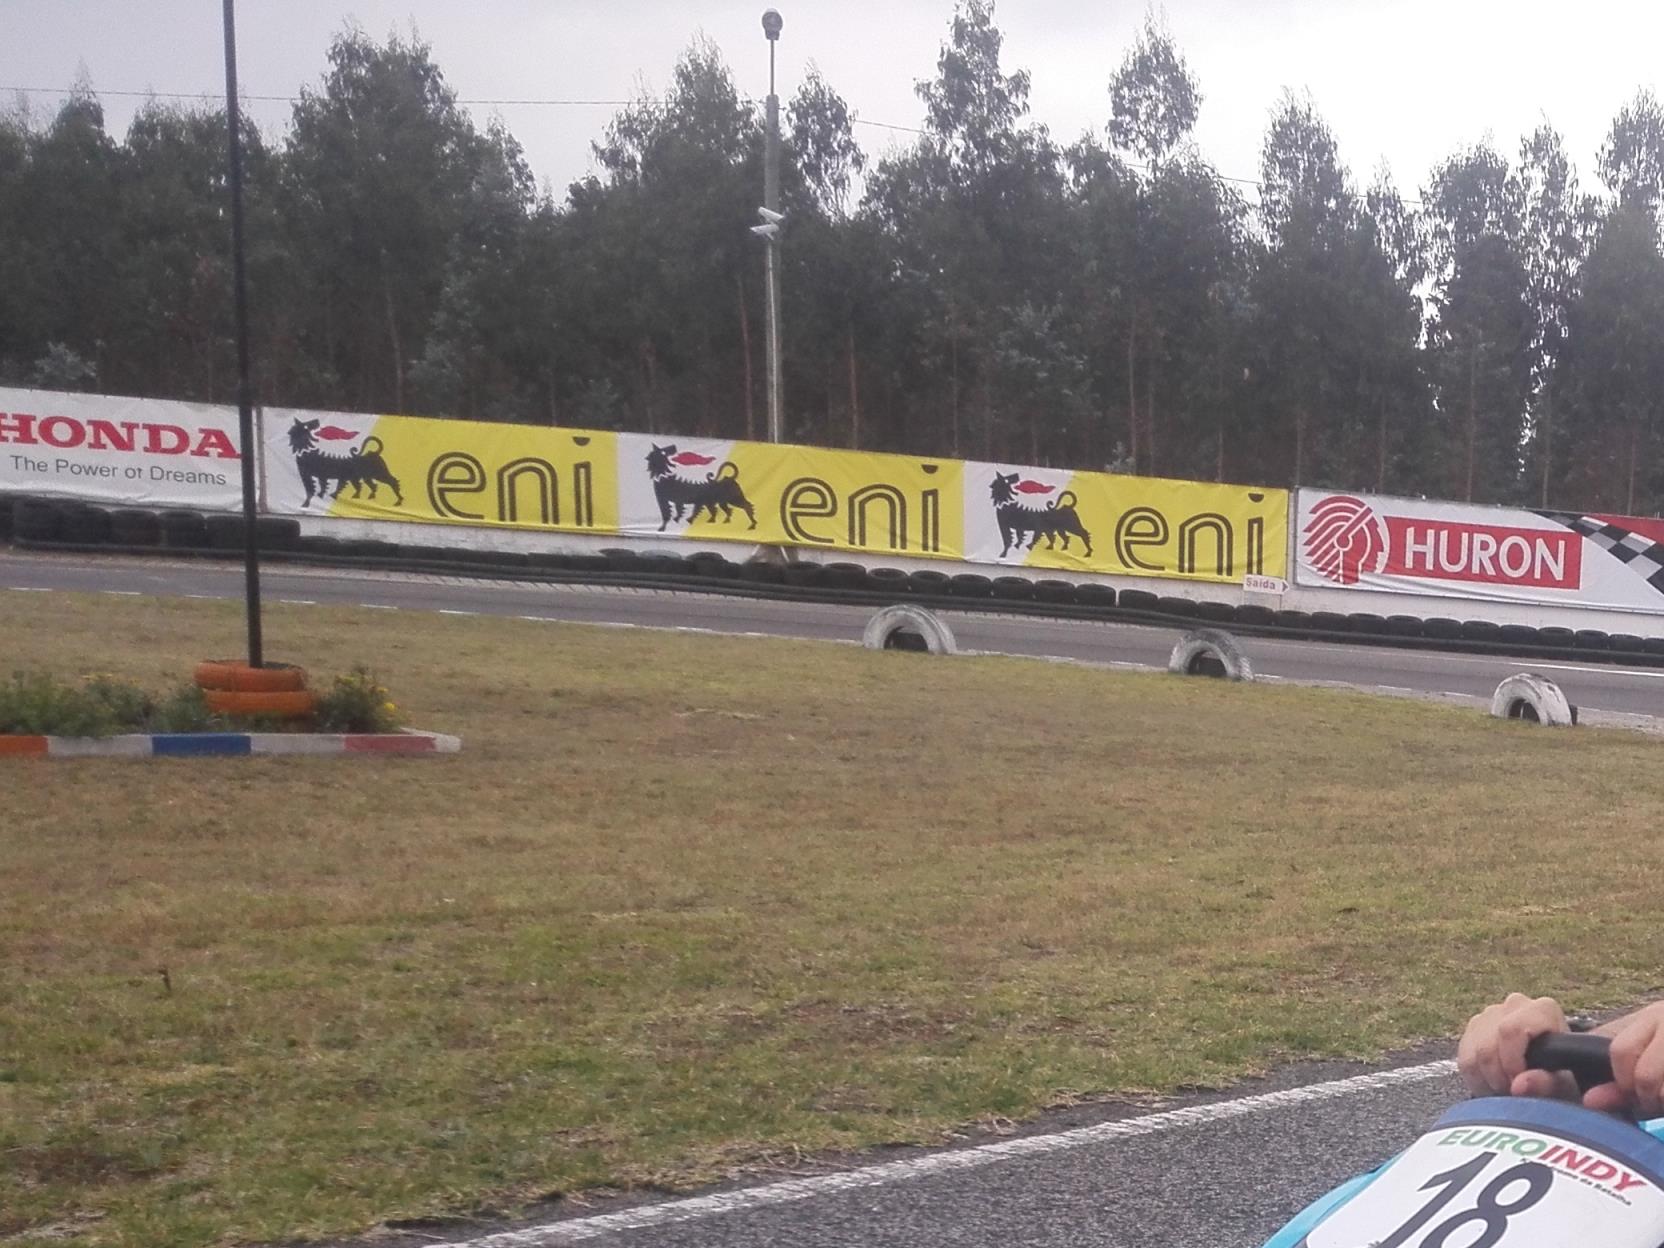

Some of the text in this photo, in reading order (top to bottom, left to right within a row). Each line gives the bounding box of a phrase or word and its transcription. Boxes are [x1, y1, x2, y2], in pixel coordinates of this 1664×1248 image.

[0, 412, 241, 459] HONDA
[10, 455, 227, 486] The Power of Dreams
[426, 436, 594, 529] eni
[779, 464, 940, 554] eni
[1113, 492, 1265, 576] eni
[1404, 526, 1566, 581] HURON
[1437, 1128, 1649, 1194] EUROINDY
